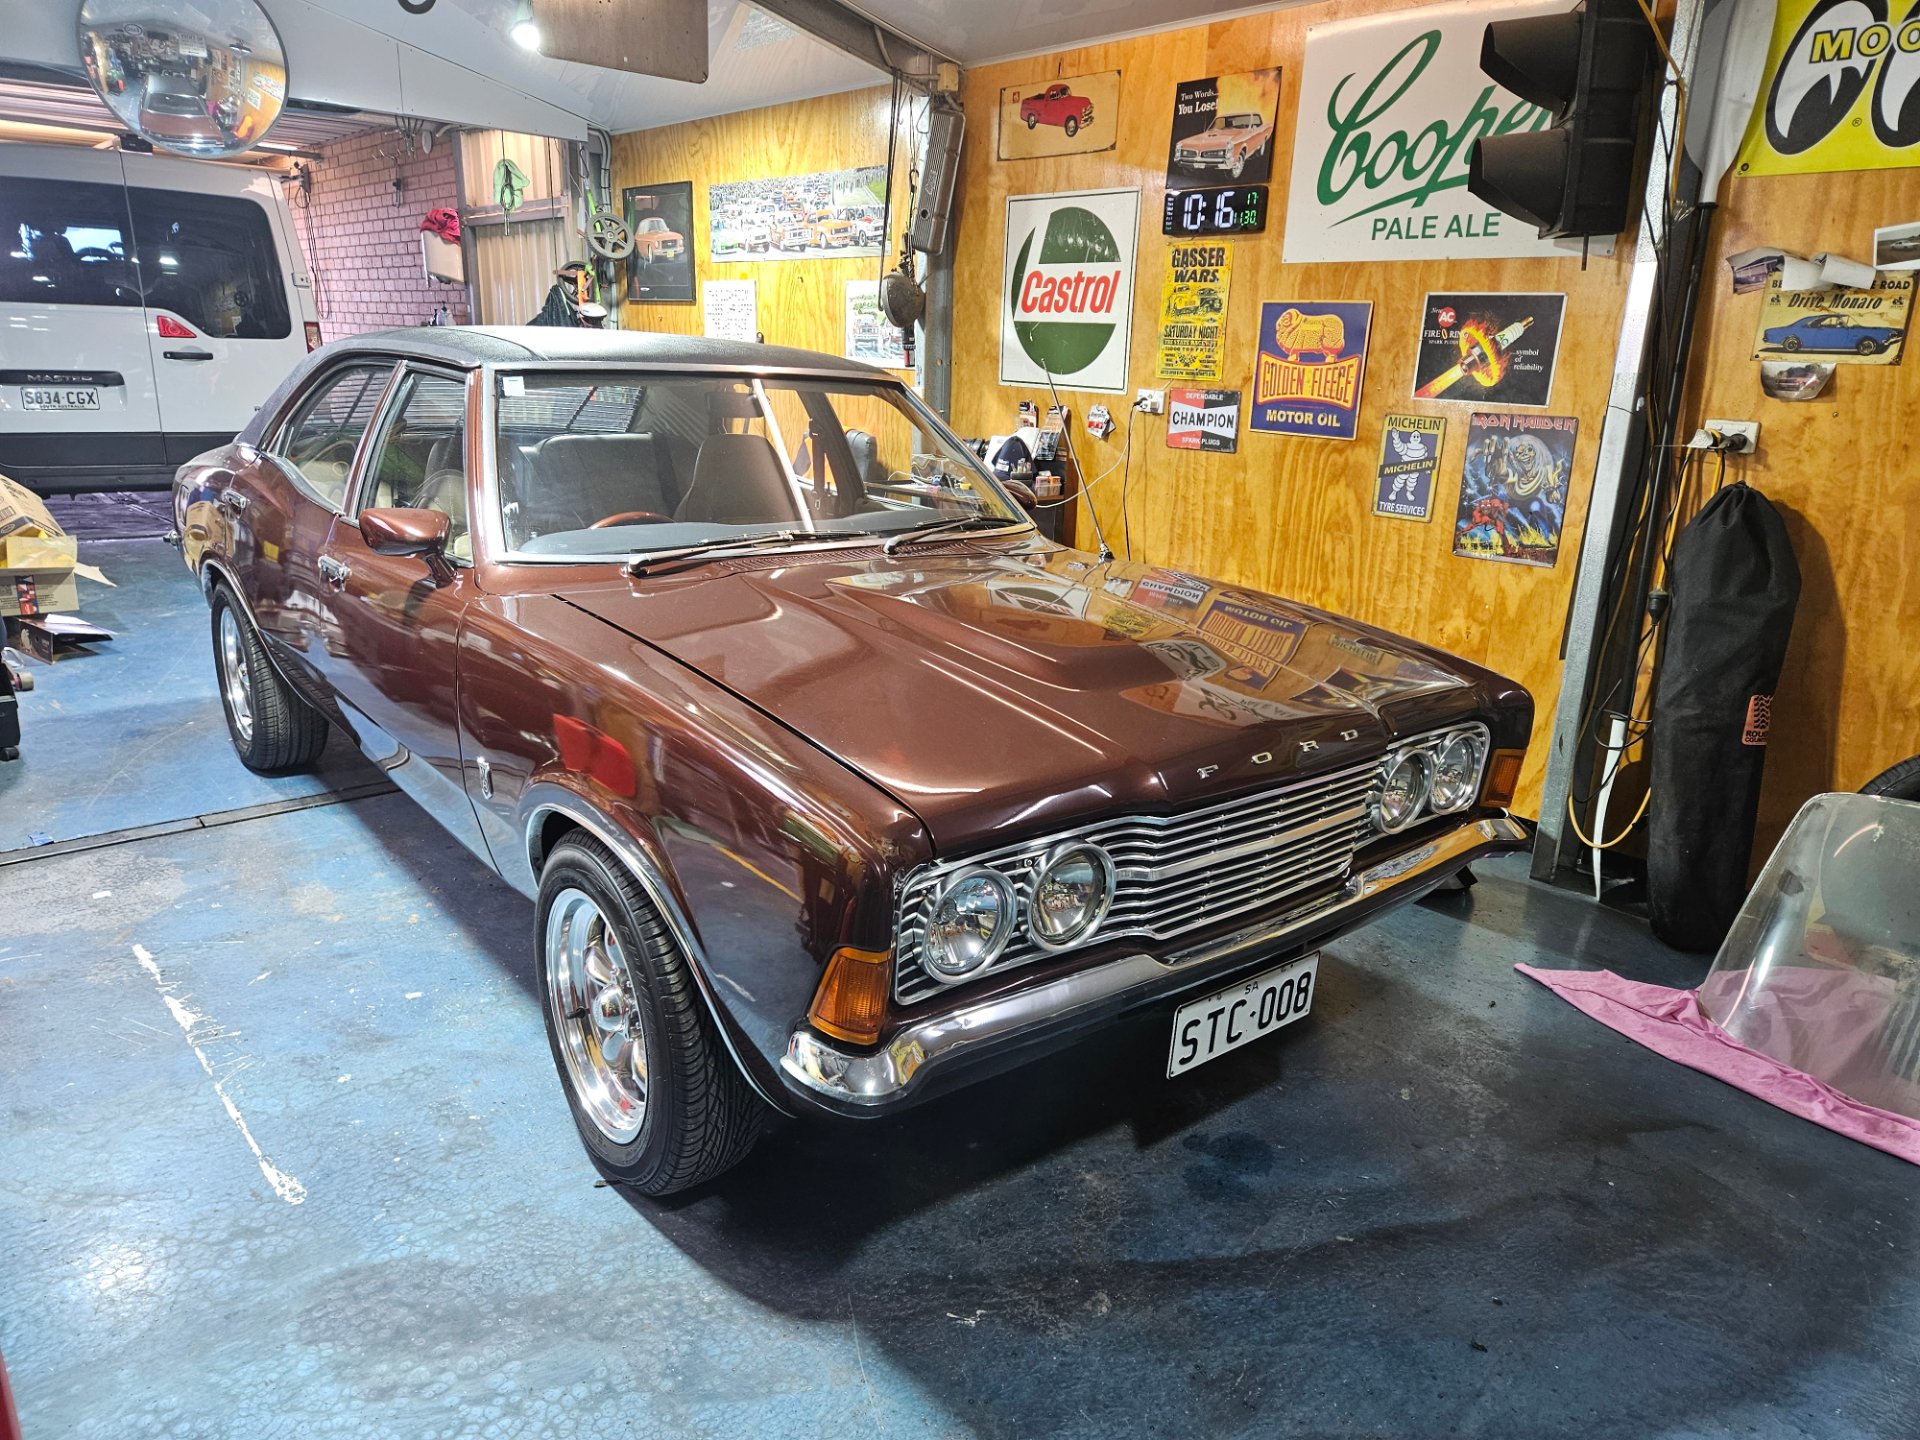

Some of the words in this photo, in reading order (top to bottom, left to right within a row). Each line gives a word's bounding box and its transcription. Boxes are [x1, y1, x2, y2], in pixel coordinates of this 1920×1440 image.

[1181, 92, 1193, 101] Two
[1178, 103, 1193, 115] You
[1317, 29, 1552, 208] Coope
[1371, 215, 1439, 241] PALE
[1444, 212, 1502, 239] ALE
[1171, 247, 1226, 268] GASSER
[1174, 268, 1219, 282] WARS
[1021, 270, 1121, 313] Castrol
[1880, 280, 1911, 290] ROAD
[1787, 291, 1825, 309] Drive
[1828, 292, 1884, 310] Monaro
[1438, 311, 1455, 322] AC
[1164, 324, 1198, 338] SATURDAY
[1199, 325, 1218, 338] NIGHT
[1424, 329, 1441, 338] FIRE
[1513, 363, 1544, 373] reliability
[1262, 360, 1306, 398] GOLDEN
[1311, 363, 1354, 403] FLEECE
[1185, 392, 1224, 400] DEPENDABLE
[1172, 411, 1235, 428] CHAMPION
[1266, 409, 1314, 425] MOTOR
[1317, 412, 1341, 427] OIL
[1387, 416, 1441, 431] MICHELIN
[1513, 415, 1575, 434] MAIDEN
[1201, 438, 1220, 446] PLUGS
[1383, 460, 1434, 475] MICHELIN
[1379, 501, 1395, 512] TYRE
[1395, 502, 1425, 517] SERVICES
[1745, 730, 1769, 738] ROU
[1197, 728, 1359, 779] FORD
[1244, 981, 1259, 995] SA
